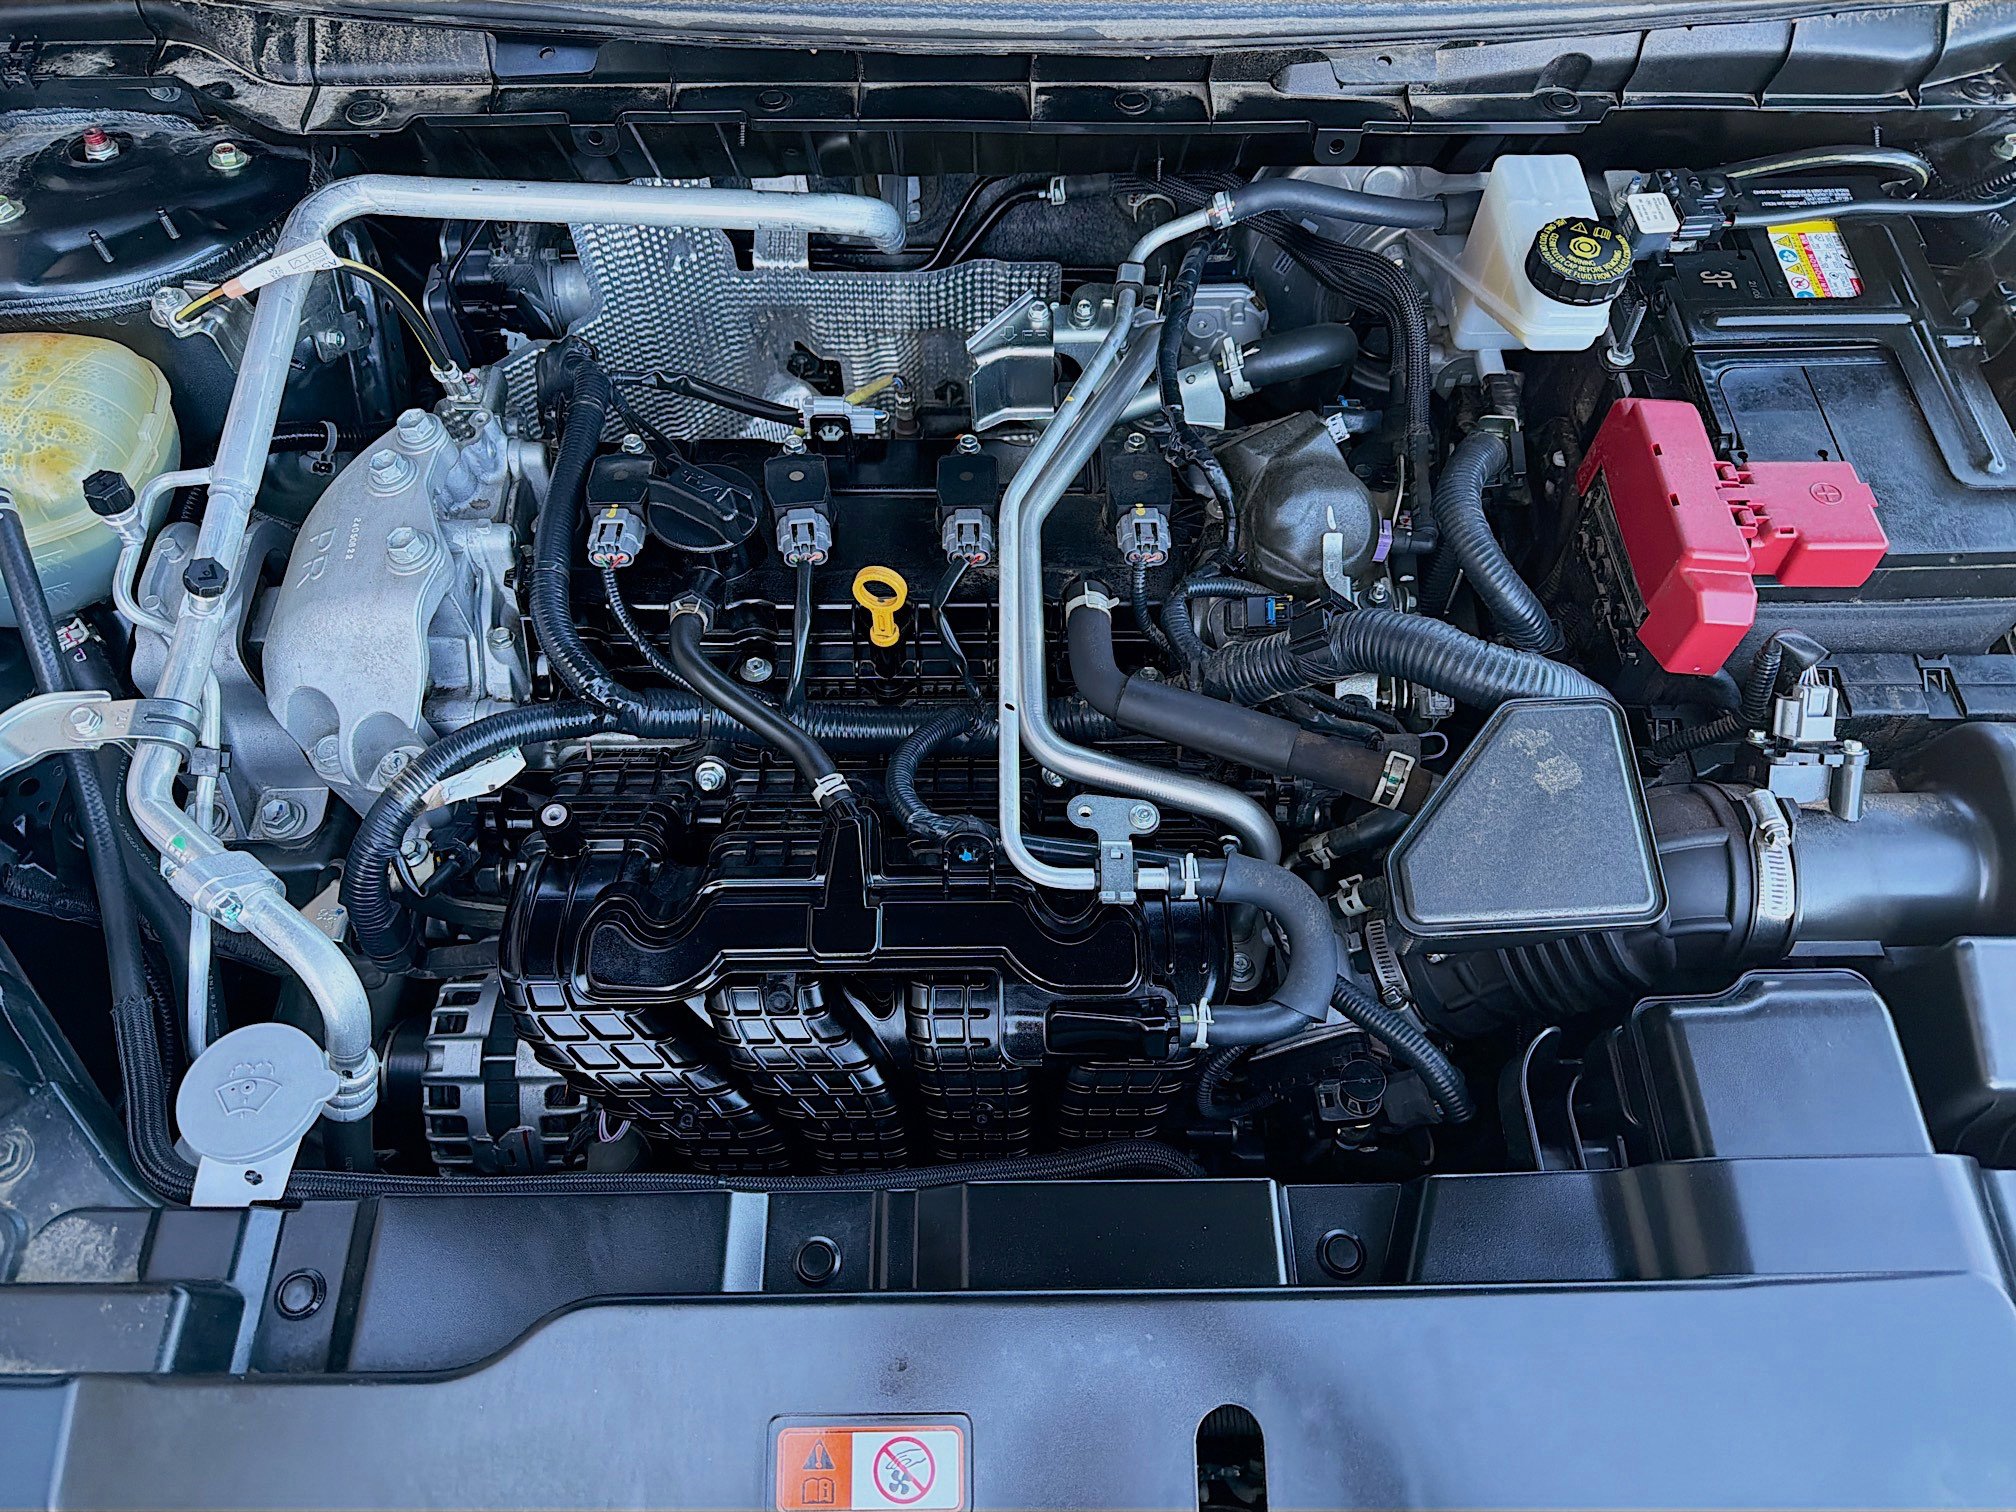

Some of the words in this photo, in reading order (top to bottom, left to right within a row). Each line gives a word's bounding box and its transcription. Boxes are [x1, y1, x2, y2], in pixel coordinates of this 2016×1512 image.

[1549, 233, 1559, 248] CLEAN
[1544, 224, 1556, 234] ONLY
[1552, 262, 1574, 276] BRAKE
[1574, 270, 1593, 280] FLUID
[1593, 272, 1611, 280] FROM
[1550, 246, 1566, 263] FILLER
[1564, 260, 1578, 270] CAP
[1566, 254, 1596, 266] WARNING
[1578, 265, 1605, 273] BEFORE
[1700, 270, 1738, 290] 3F
